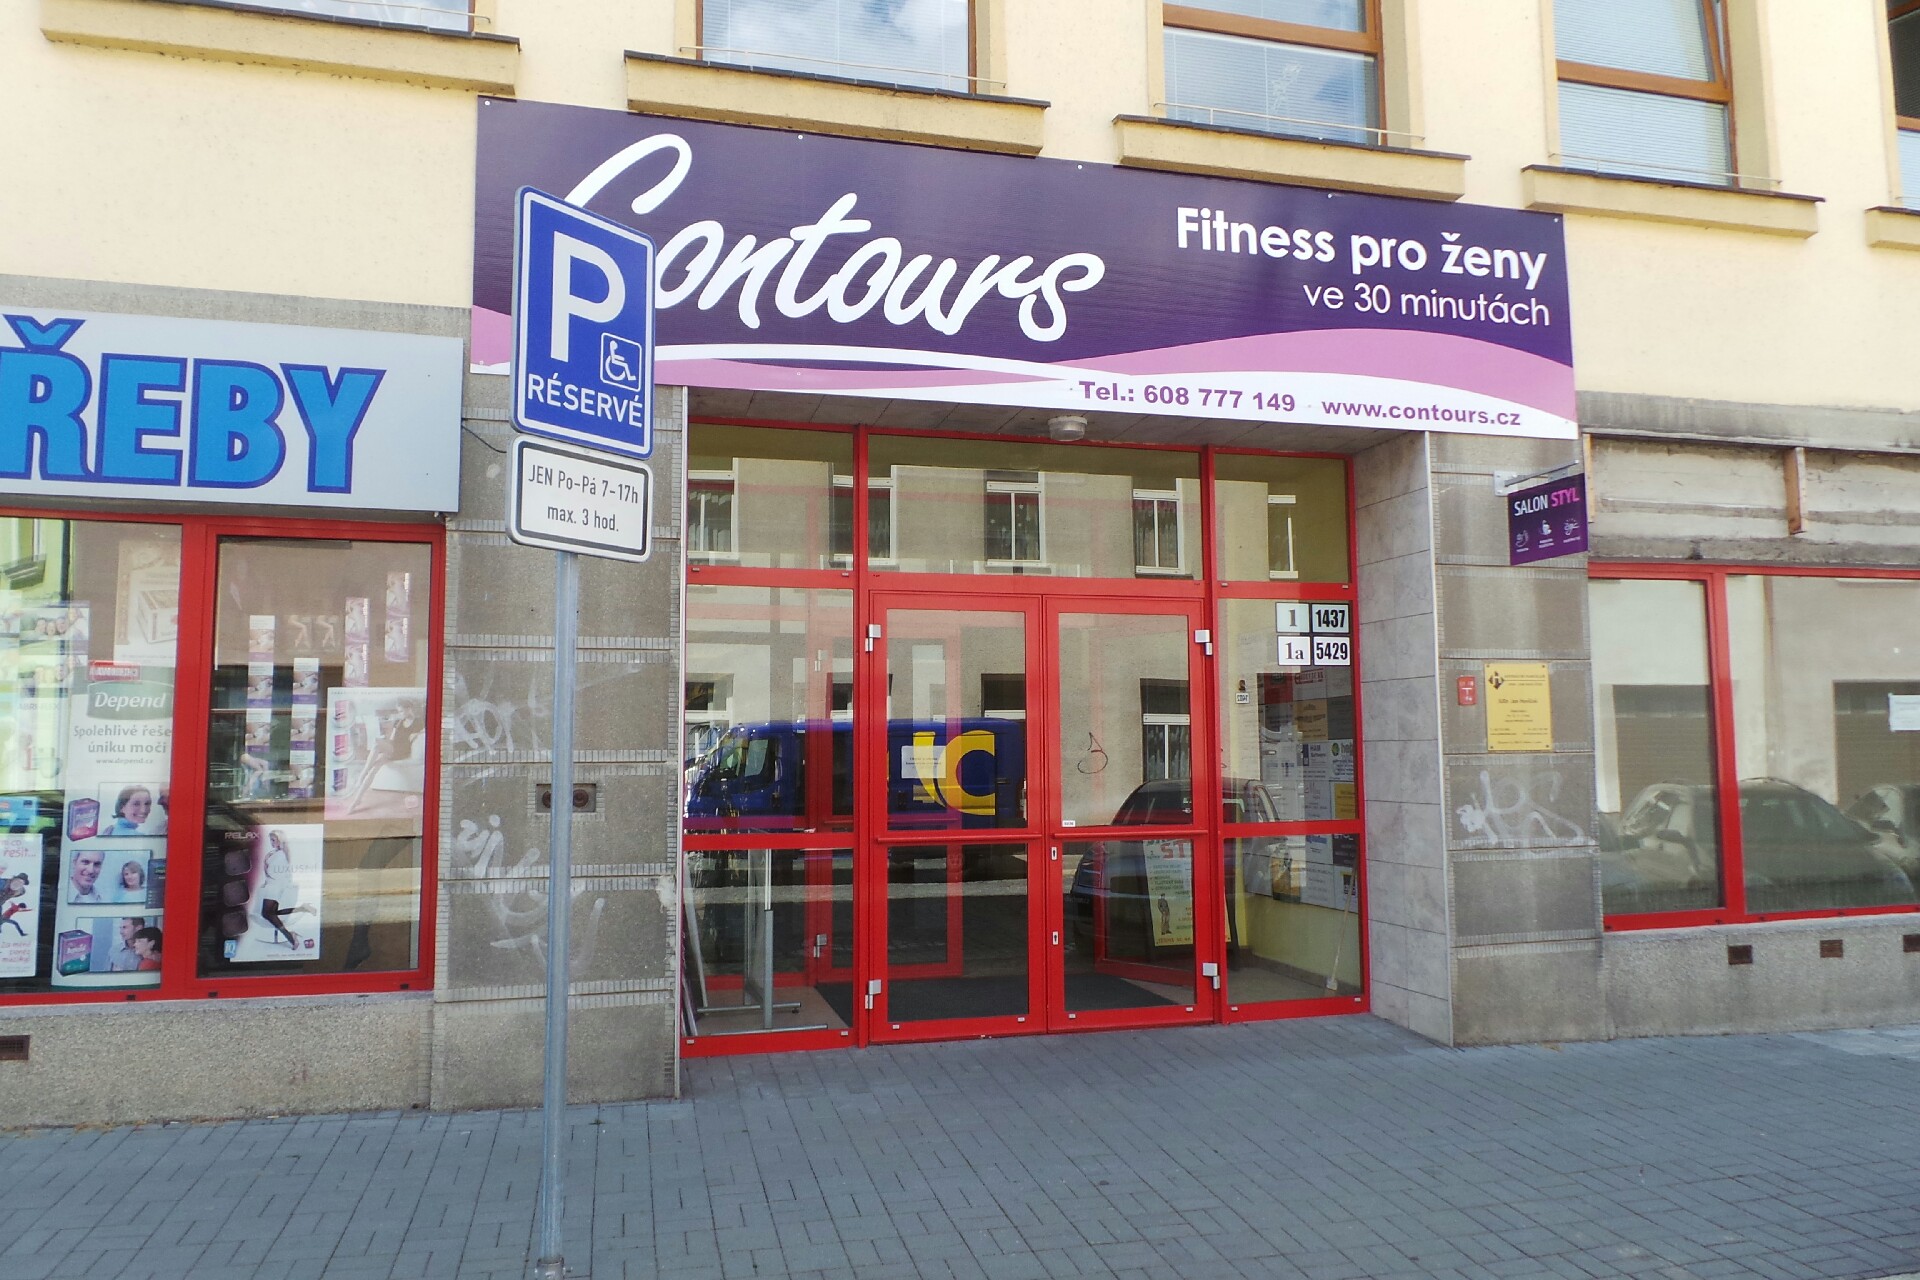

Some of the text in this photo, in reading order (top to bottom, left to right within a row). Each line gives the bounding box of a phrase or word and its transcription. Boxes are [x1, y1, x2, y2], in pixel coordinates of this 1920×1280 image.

[1177, 205, 1548, 291] Fitness pro ženy
[551, 231, 626, 363] P
[1303, 282, 1551, 328] ve 30 minutách
[0, 314, 387, 494] ŘEBY
[527, 372, 644, 428] RÉSERVÉ
[1079, 380, 1296, 413] Tel.: 608 777 149
[1321, 397, 1522, 428] www.contours.cz
[528, 464, 553, 486] JEN
[602, 480, 639, 504] 7-17h
[1514, 487, 1580, 516] SALON STYL
[547, 506, 619, 532] max. 3 hod.
[1288, 609, 1297, 627] 1
[1315, 609, 1346, 628] 1437
[1285, 642, 1304, 660] 1a
[1316, 642, 1348, 660] 5429
[94, 691, 167, 712] Depend
[73, 724, 139, 740] Spolehlivé
[88, 741, 167, 754] úniku moči
